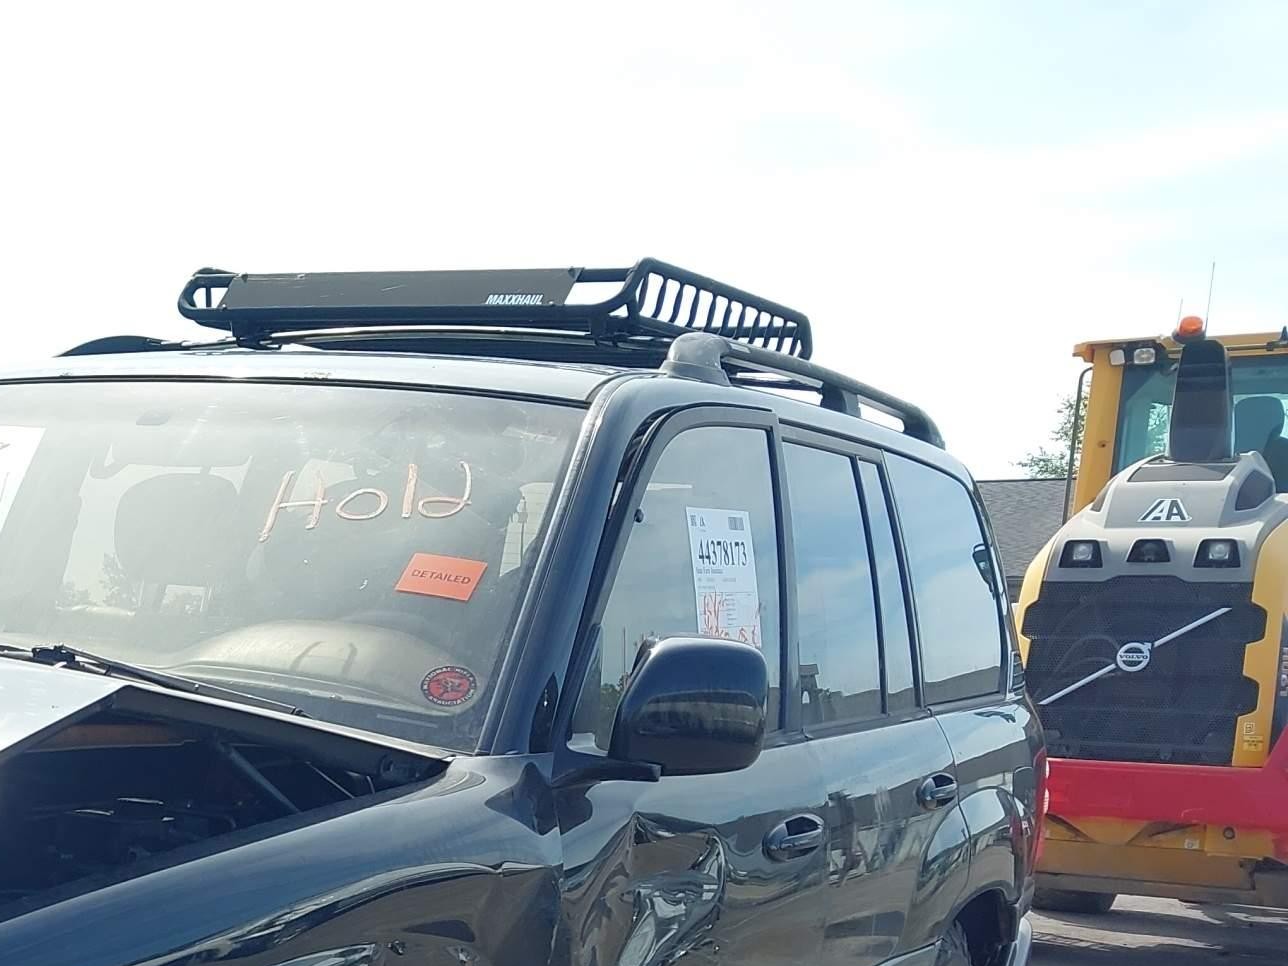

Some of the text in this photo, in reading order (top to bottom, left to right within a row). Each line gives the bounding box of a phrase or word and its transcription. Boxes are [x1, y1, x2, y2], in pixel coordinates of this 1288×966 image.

[485, 294, 544, 304] MAXXHAUL
[258, 460, 471, 541] Hold
[698, 539, 747, 566] 44378173
[412, 569, 471, 584] DETAILED
